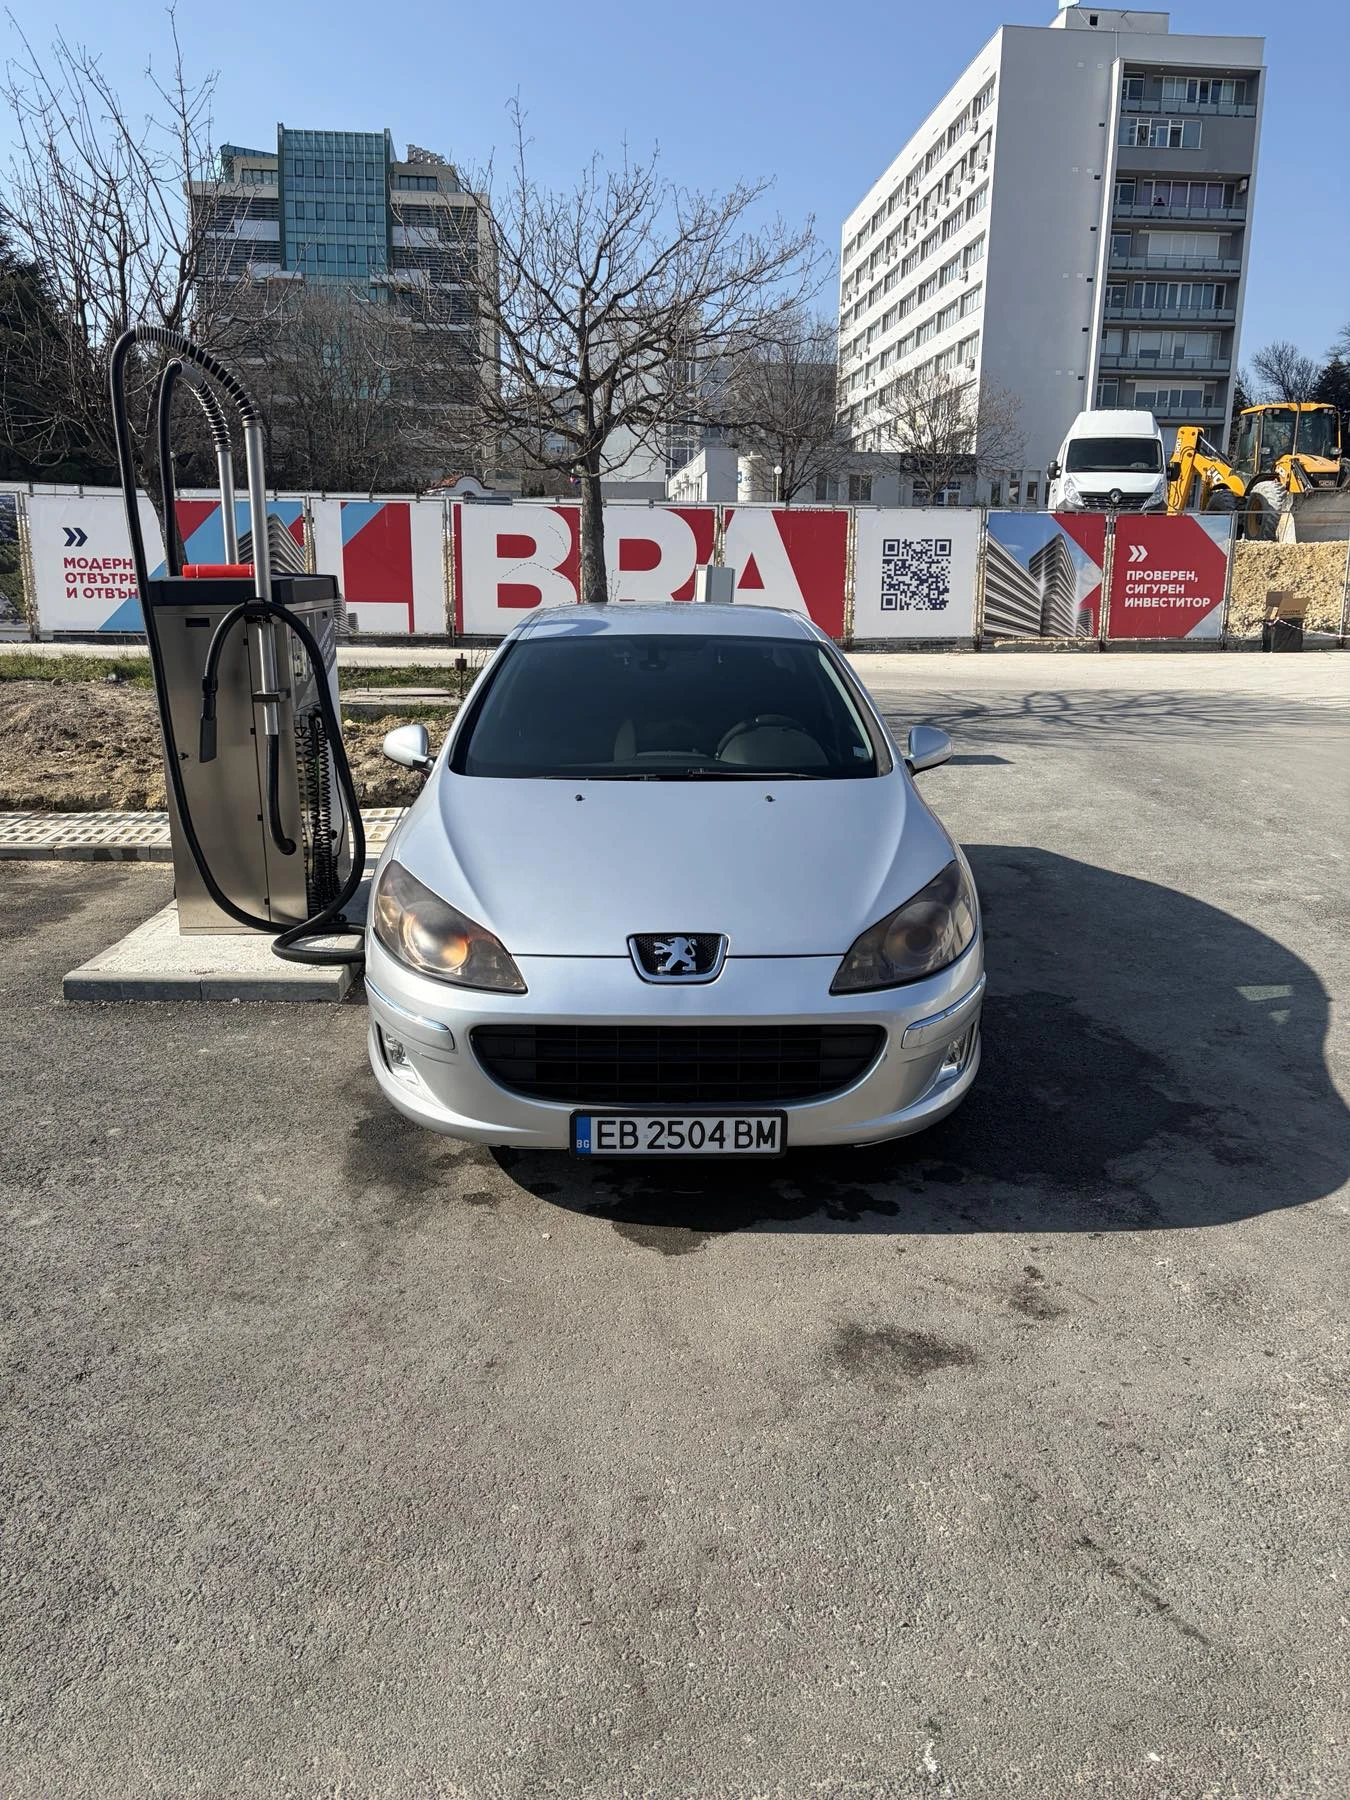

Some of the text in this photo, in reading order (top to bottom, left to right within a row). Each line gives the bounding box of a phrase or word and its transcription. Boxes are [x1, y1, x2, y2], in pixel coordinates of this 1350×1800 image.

[314, 503, 812, 634] LIBRA
[65, 572, 137, 585] ОТВЪТРЕ
[1126, 570, 1198, 583] ПРОВЕРЕН,
[66, 587, 139, 600] И ОТВЪН
[1125, 584, 1185, 594] СИГУРЕН
[1124, 597, 1211, 608] ИНВЕСТИТОР
[576, 1120, 777, 1150] BG EB 2504 BM
